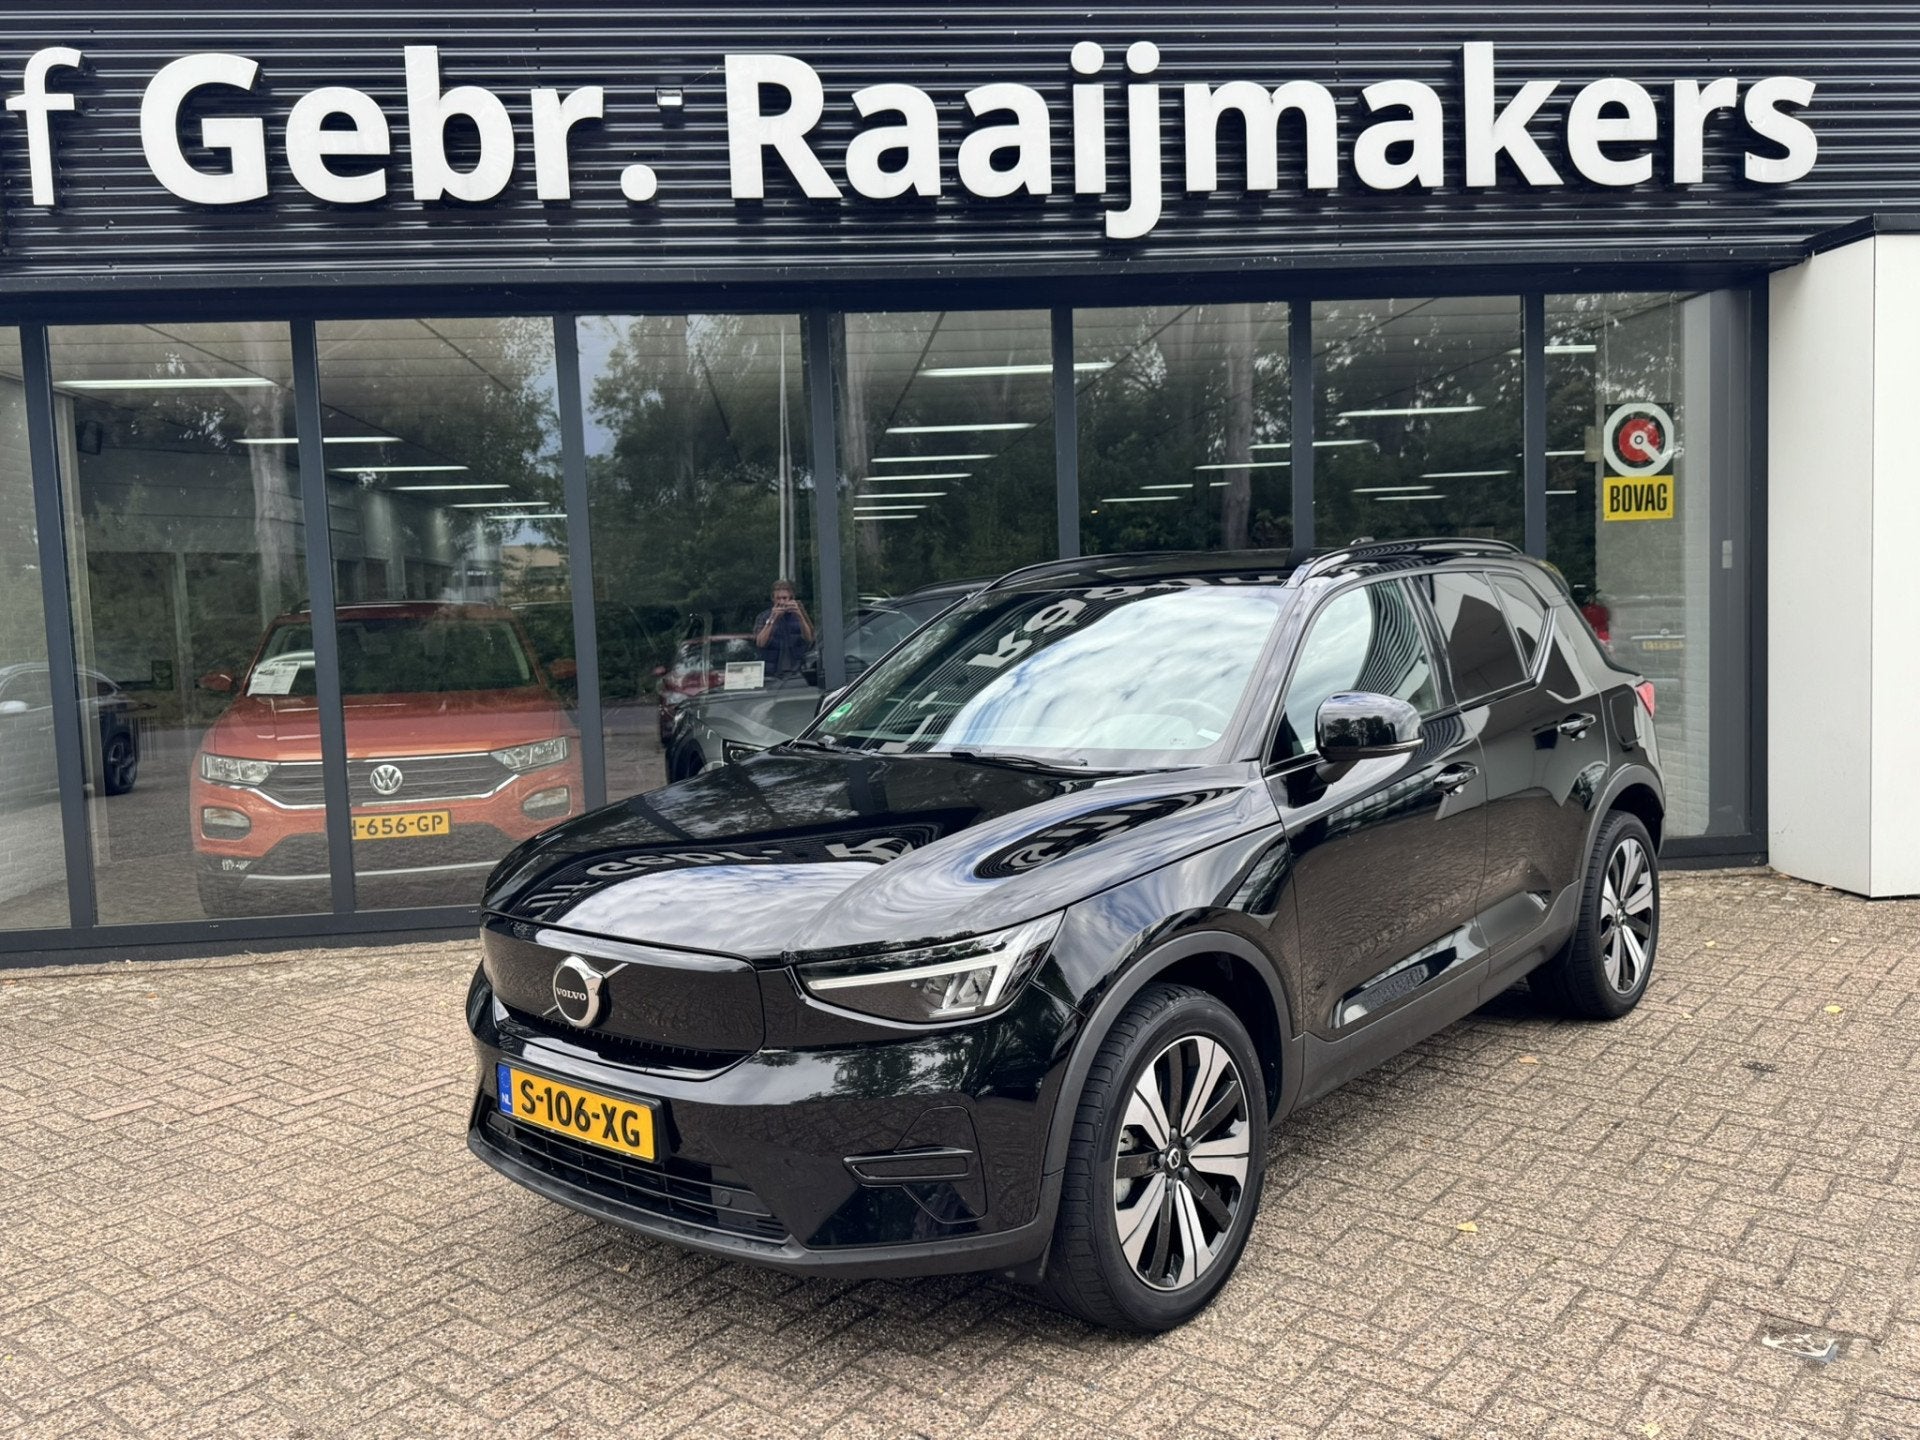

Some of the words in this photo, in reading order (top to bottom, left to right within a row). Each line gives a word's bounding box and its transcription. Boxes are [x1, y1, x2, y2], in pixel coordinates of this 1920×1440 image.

[140, 45, 657, 204] Gebr.
[724, 41, 1819, 239] Raaijmakers
[1609, 483, 1668, 513] BOVAG
[556, 987, 587, 1001] VOLVO
[520, 1079, 641, 1148] S-106-XG
